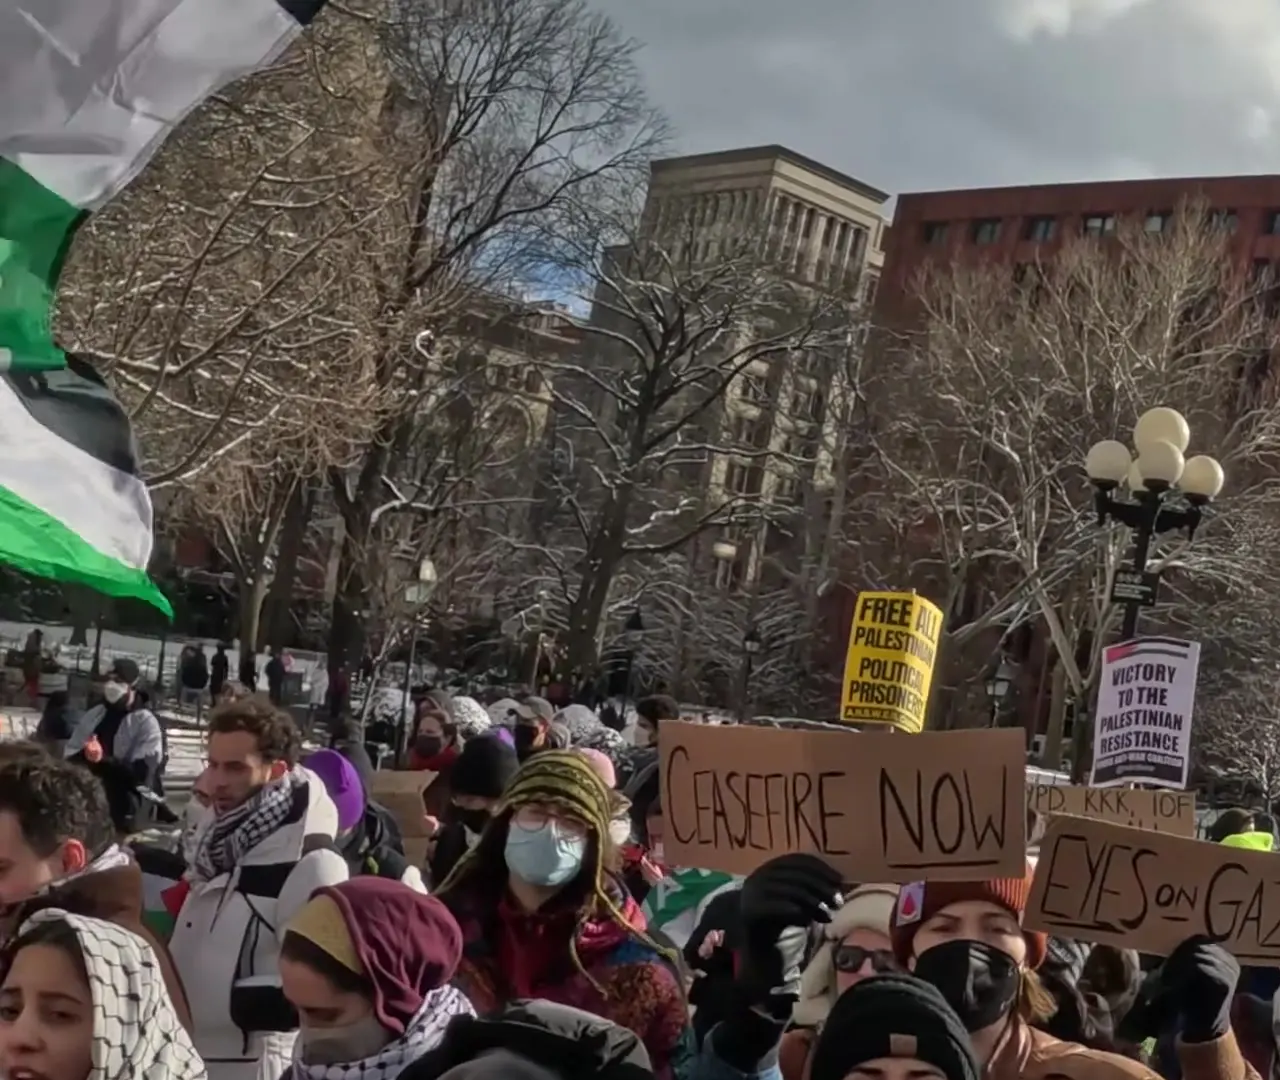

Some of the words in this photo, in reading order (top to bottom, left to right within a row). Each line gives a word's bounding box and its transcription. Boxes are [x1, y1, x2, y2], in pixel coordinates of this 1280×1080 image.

[859, 598, 913, 628] FREE
[916, 605, 937, 644] ALL
[1112, 663, 1176, 686] VICTORY
[1118, 689, 1133, 708] TO
[1137, 687, 1168, 706] THE
[1101, 709, 1183, 733] PALESTINIAN
[1101, 731, 1179, 754] RESISTANCE
[666, 745, 849, 855] CEASEFIRE
[879, 765, 1006, 857] NOW
[1153, 793, 1191, 818] IOF
[1041, 834, 1158, 930] EYES
